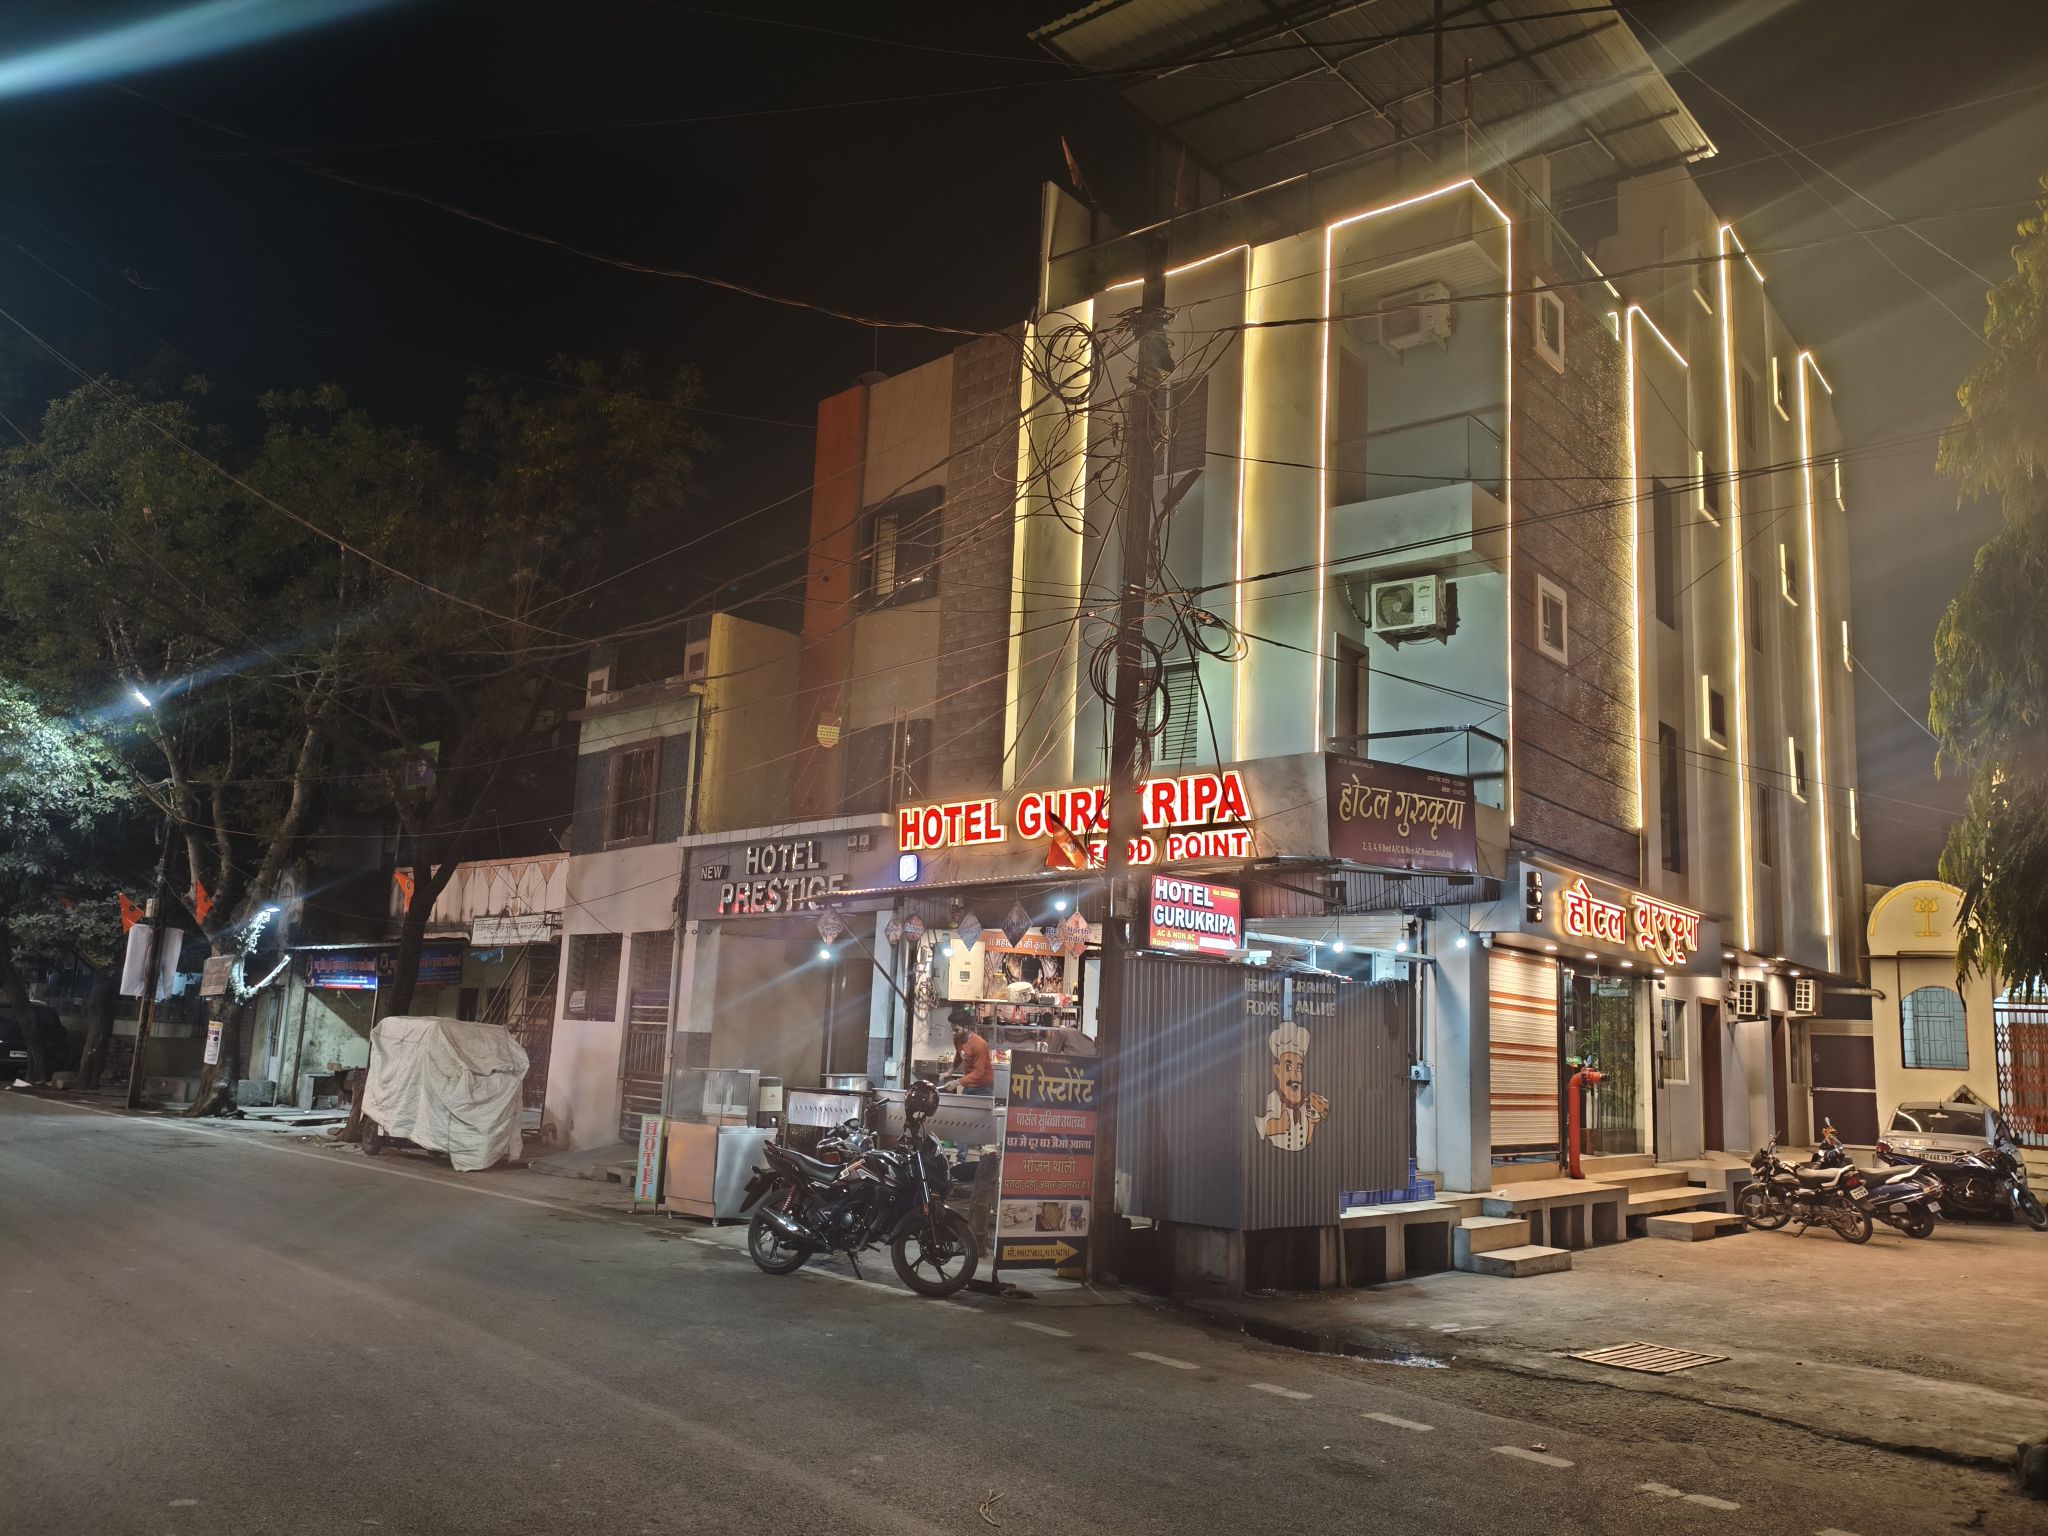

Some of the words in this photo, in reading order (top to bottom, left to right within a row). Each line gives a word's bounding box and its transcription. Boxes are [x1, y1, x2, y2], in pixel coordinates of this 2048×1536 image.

[1340, 774, 1392, 821] होटल
[899, 799, 1006, 851] HOTEL
[746, 841, 820, 875] HOTEL
[1167, 828, 1252, 861] POINT
[701, 866, 723, 880] NEW
[718, 874, 844, 915] PRESTIGE
[1155, 878, 1214, 908] HOTEL
[1153, 904, 1237, 936] GURUKRIPA
[1566, 879, 1626, 944] होटल
[1023, 937, 1032, 949] की
[1067, 927, 1090, 936] North
[1152, 937, 1170, 947] Room
[1157, 929, 1166, 937] AC
[1173, 931, 1186, 940] NON
[1187, 932, 1196, 940] AC
[1246, 1000, 1280, 1017] ROOMS
[1012, 1064, 1034, 1099] माँ
[1007, 1137, 1017, 1147] घर
[1040, 1138, 1051, 1148] घर
